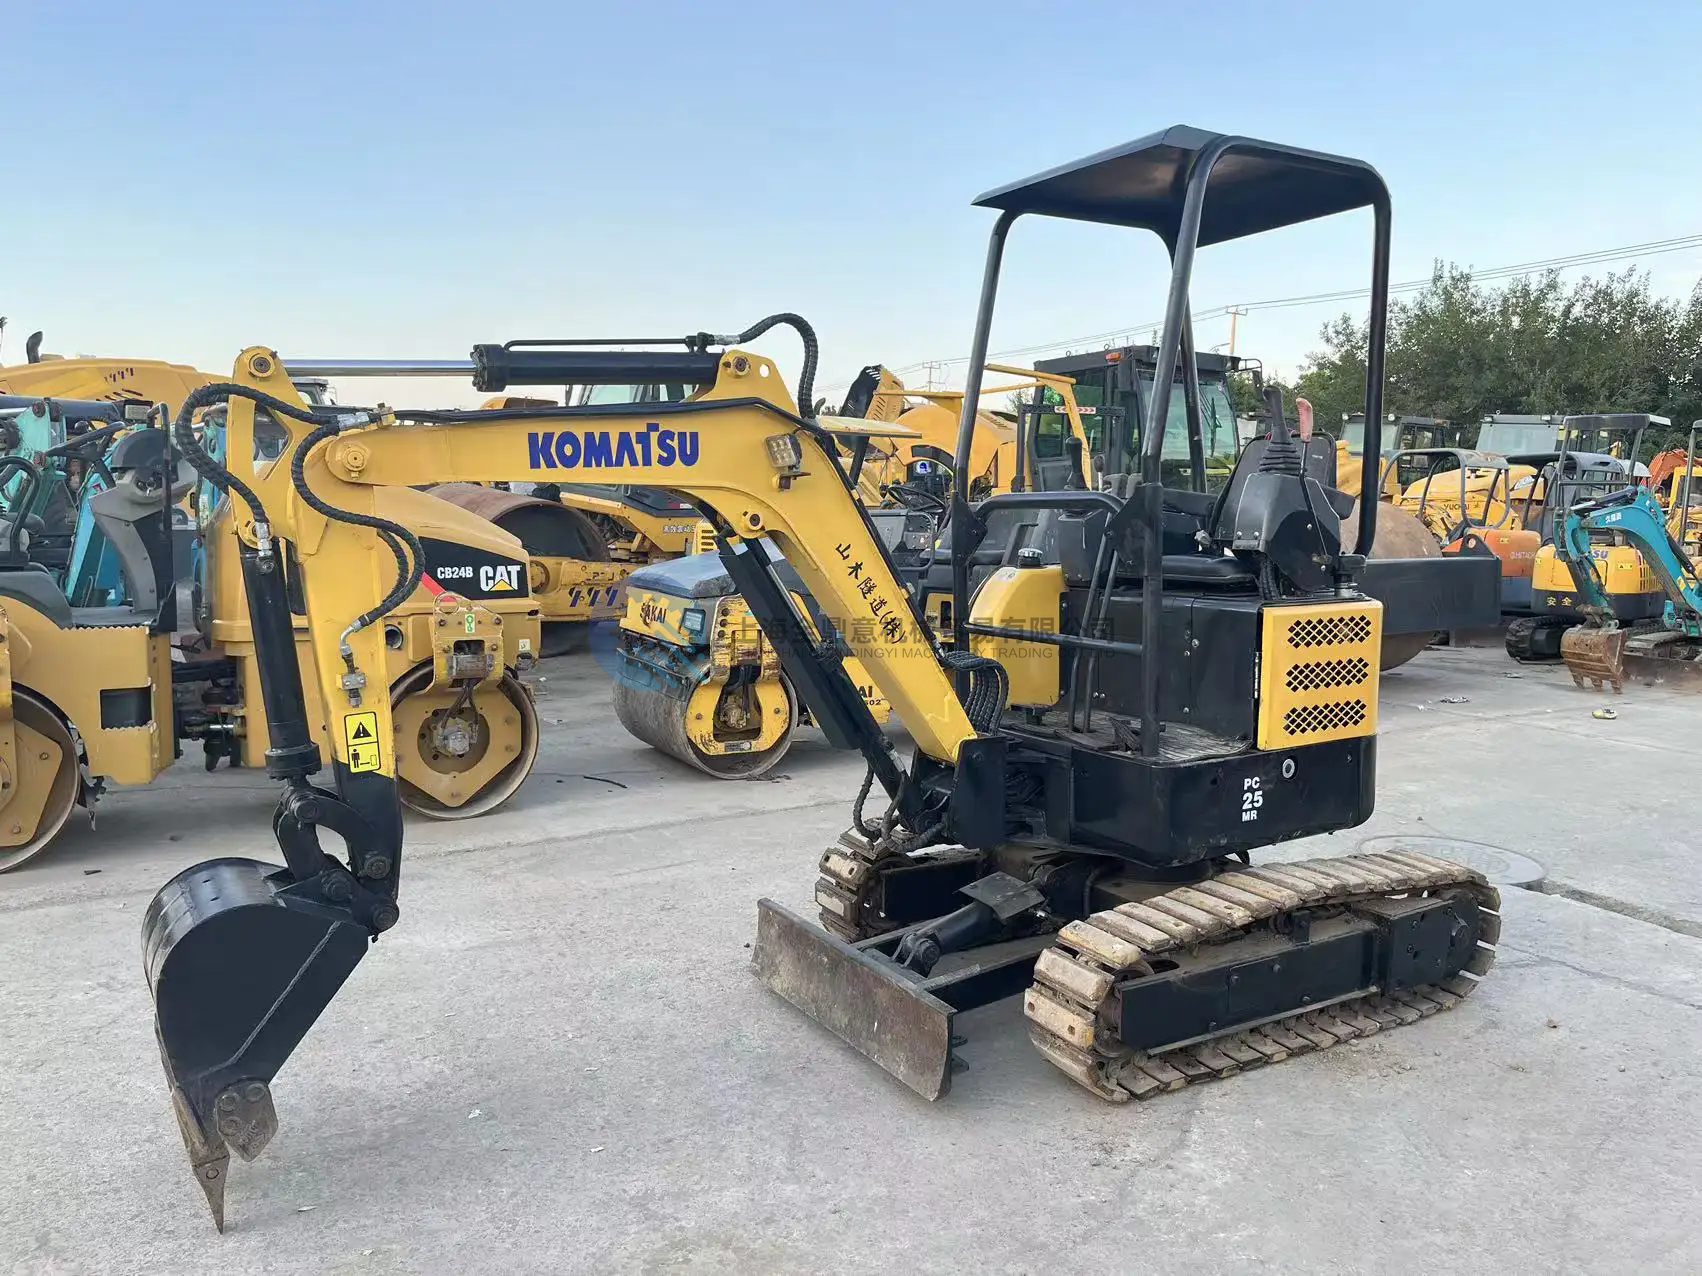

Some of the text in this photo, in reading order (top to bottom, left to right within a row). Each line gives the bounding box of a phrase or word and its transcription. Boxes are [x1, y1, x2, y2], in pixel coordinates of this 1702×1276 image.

[528, 423, 700, 469] KOMATSU
[1514, 551, 1537, 559] HITACH
[436, 566, 474, 579] CB24B
[480, 565, 521, 592] CAT
[1546, 596, 1572, 607] 安全
[1243, 776, 1260, 790] PC
[1241, 790, 1263, 810] 25
[1241, 810, 1258, 822] MR
